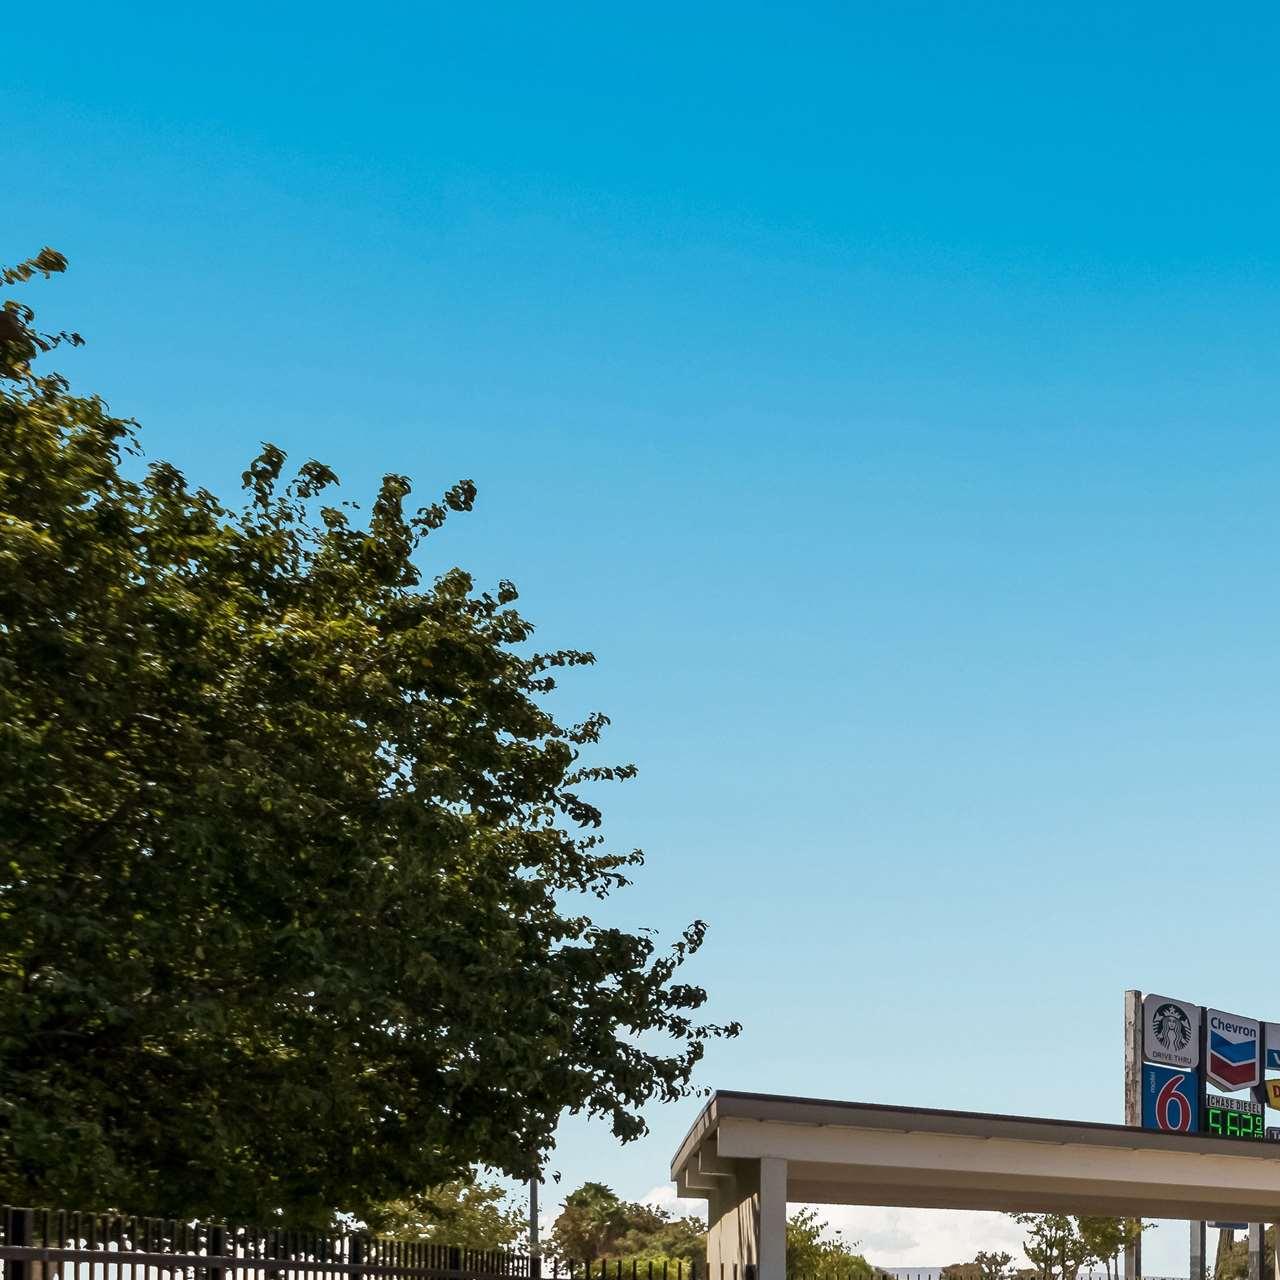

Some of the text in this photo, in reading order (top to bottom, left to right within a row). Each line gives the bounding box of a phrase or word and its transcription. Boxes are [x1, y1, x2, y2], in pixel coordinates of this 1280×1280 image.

[1210, 1016, 1257, 1038] Chevron
[1155, 1074, 1192, 1132] 6
[1236, 1101, 1262, 1114] DIESEL
